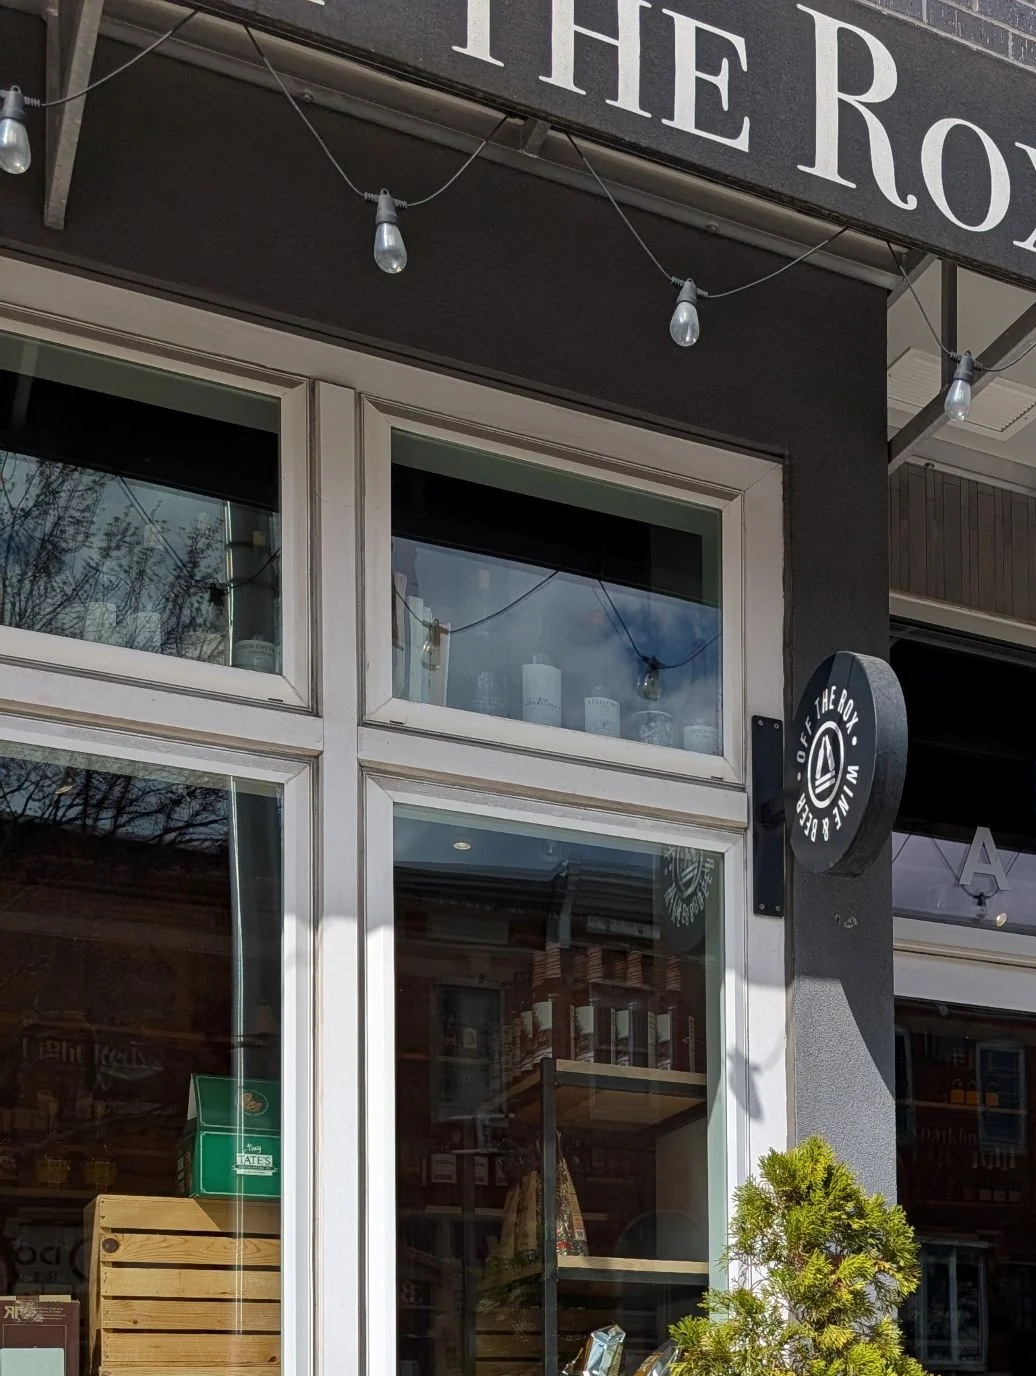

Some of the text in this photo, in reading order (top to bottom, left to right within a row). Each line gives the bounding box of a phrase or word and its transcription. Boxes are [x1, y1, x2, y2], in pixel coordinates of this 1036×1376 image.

[796, 685, 859, 764] OFF THE ROX
[796, 765, 860, 843] WINE & BEER
[959, 826, 1010, 891] A
